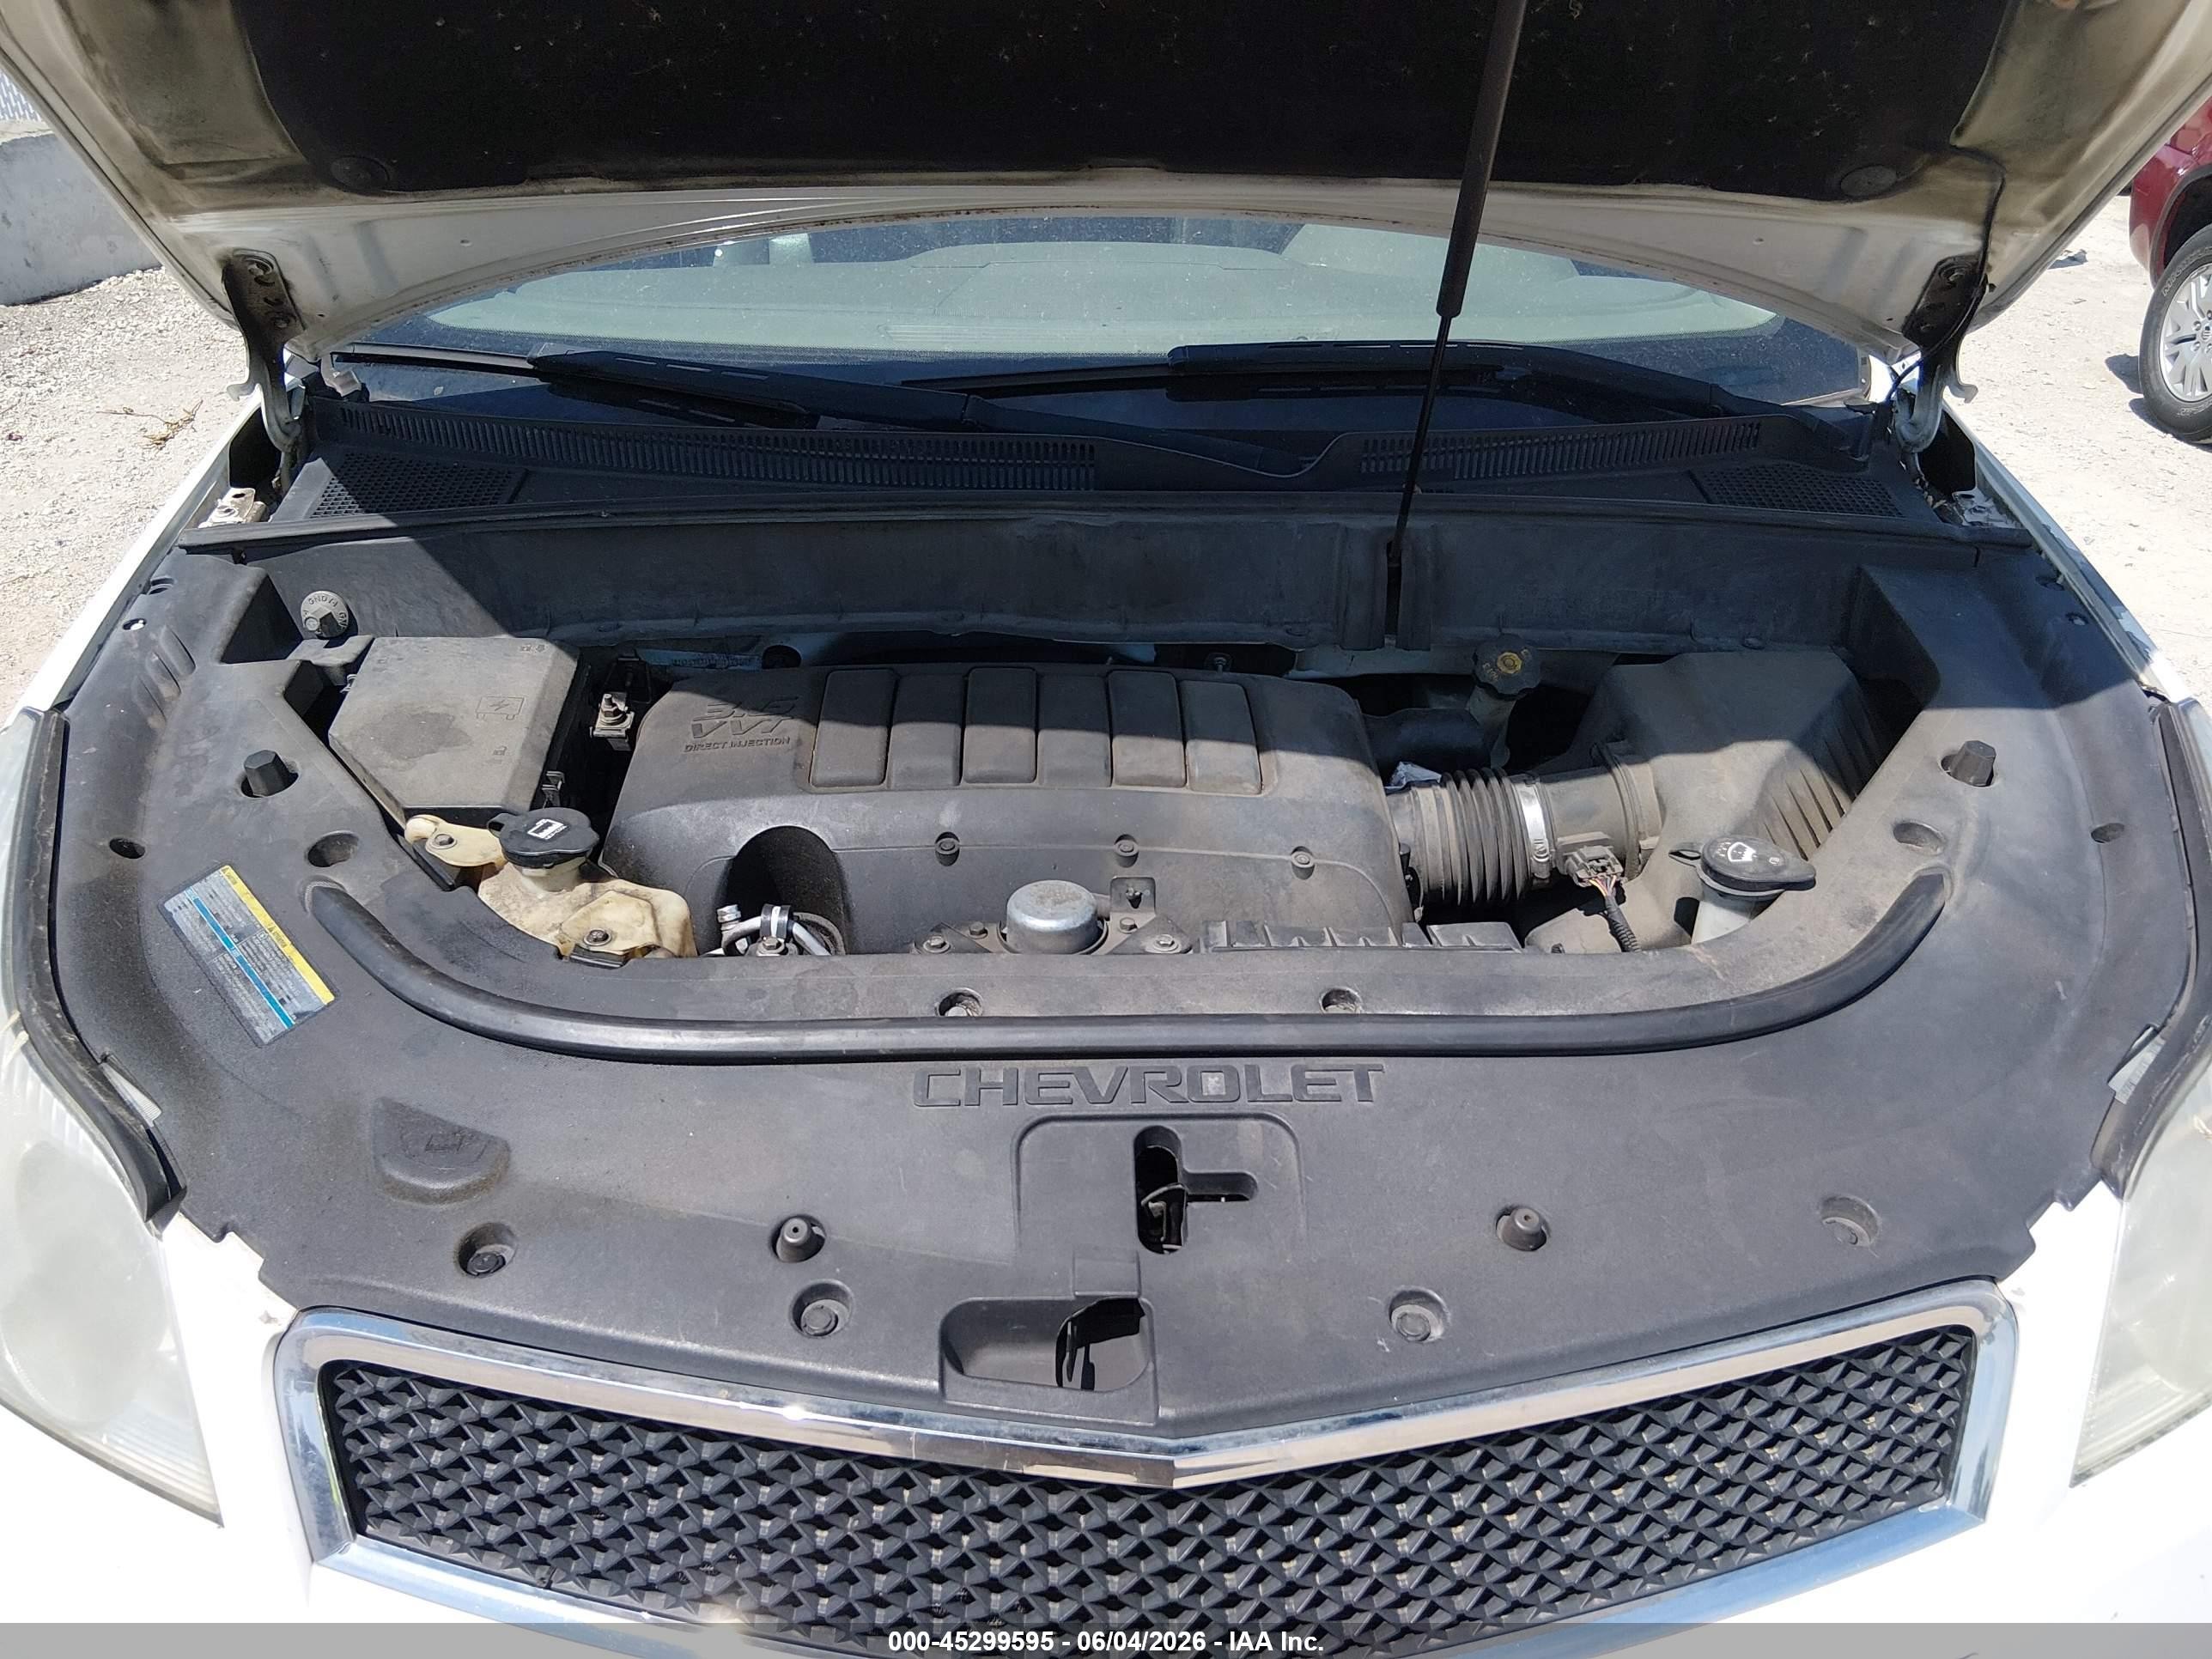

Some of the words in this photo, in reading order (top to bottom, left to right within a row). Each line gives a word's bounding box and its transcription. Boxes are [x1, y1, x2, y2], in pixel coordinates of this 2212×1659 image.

[690, 716, 794, 739] VVT
[684, 740, 728, 753] DIRECT
[730, 736, 791, 748] INJECTION
[913, 1064, 1384, 1107] CHEVROLET
